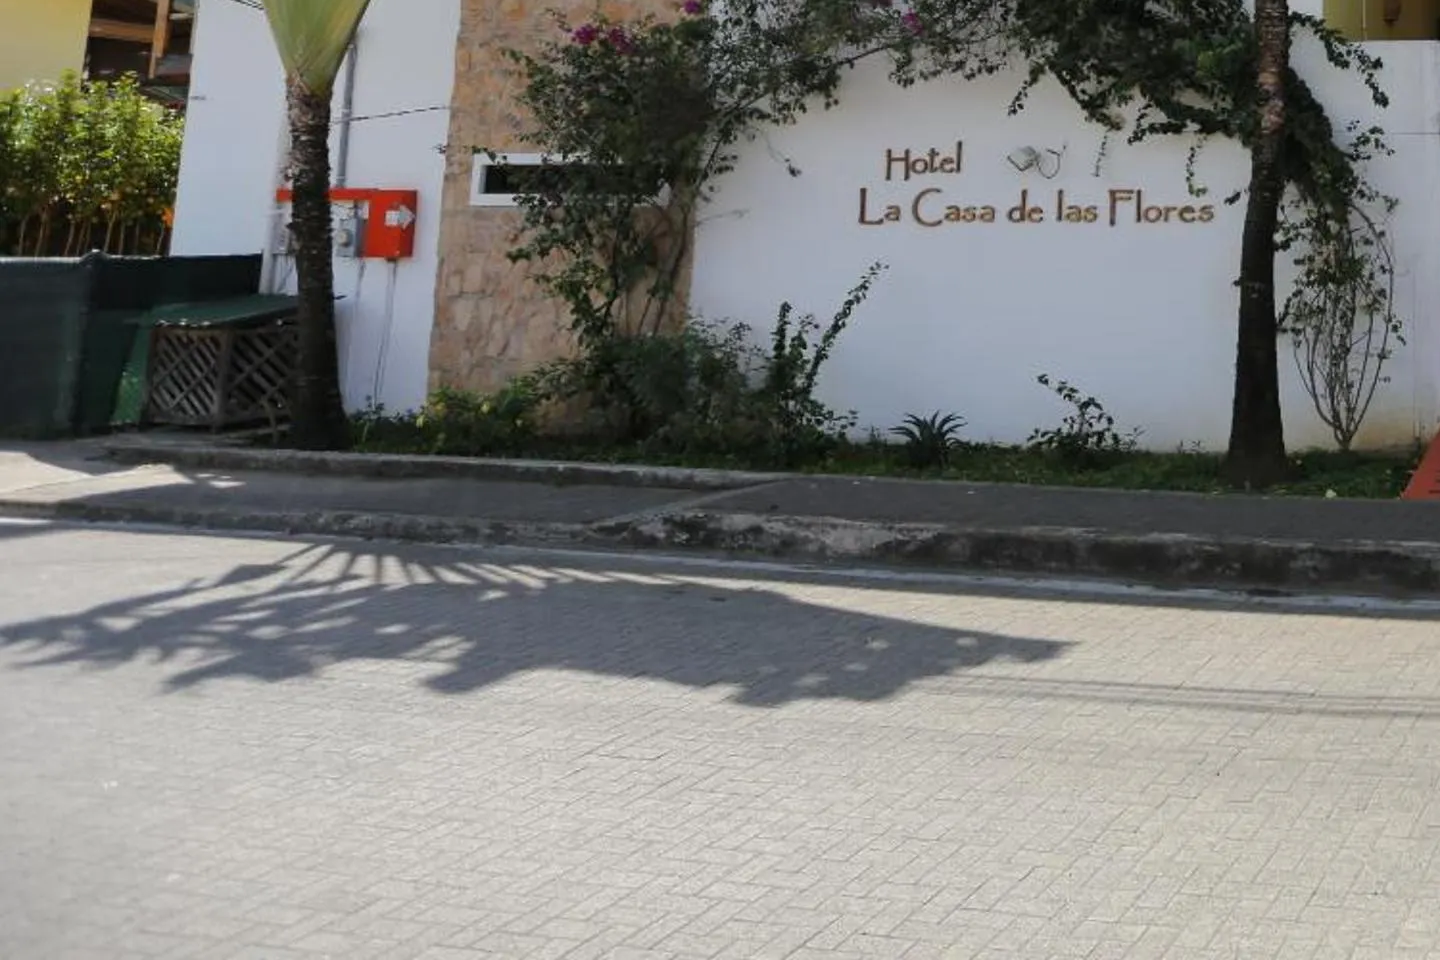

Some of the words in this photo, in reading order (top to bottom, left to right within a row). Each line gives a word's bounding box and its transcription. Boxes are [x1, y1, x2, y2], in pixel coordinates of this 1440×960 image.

[885, 140, 963, 181] Hotel
[858, 188, 901, 227] La
[911, 188, 995, 227] Casa
[1006, 189, 1044, 223] de
[1056, 189, 1098, 223] las
[1109, 189, 1215, 227] Flores
